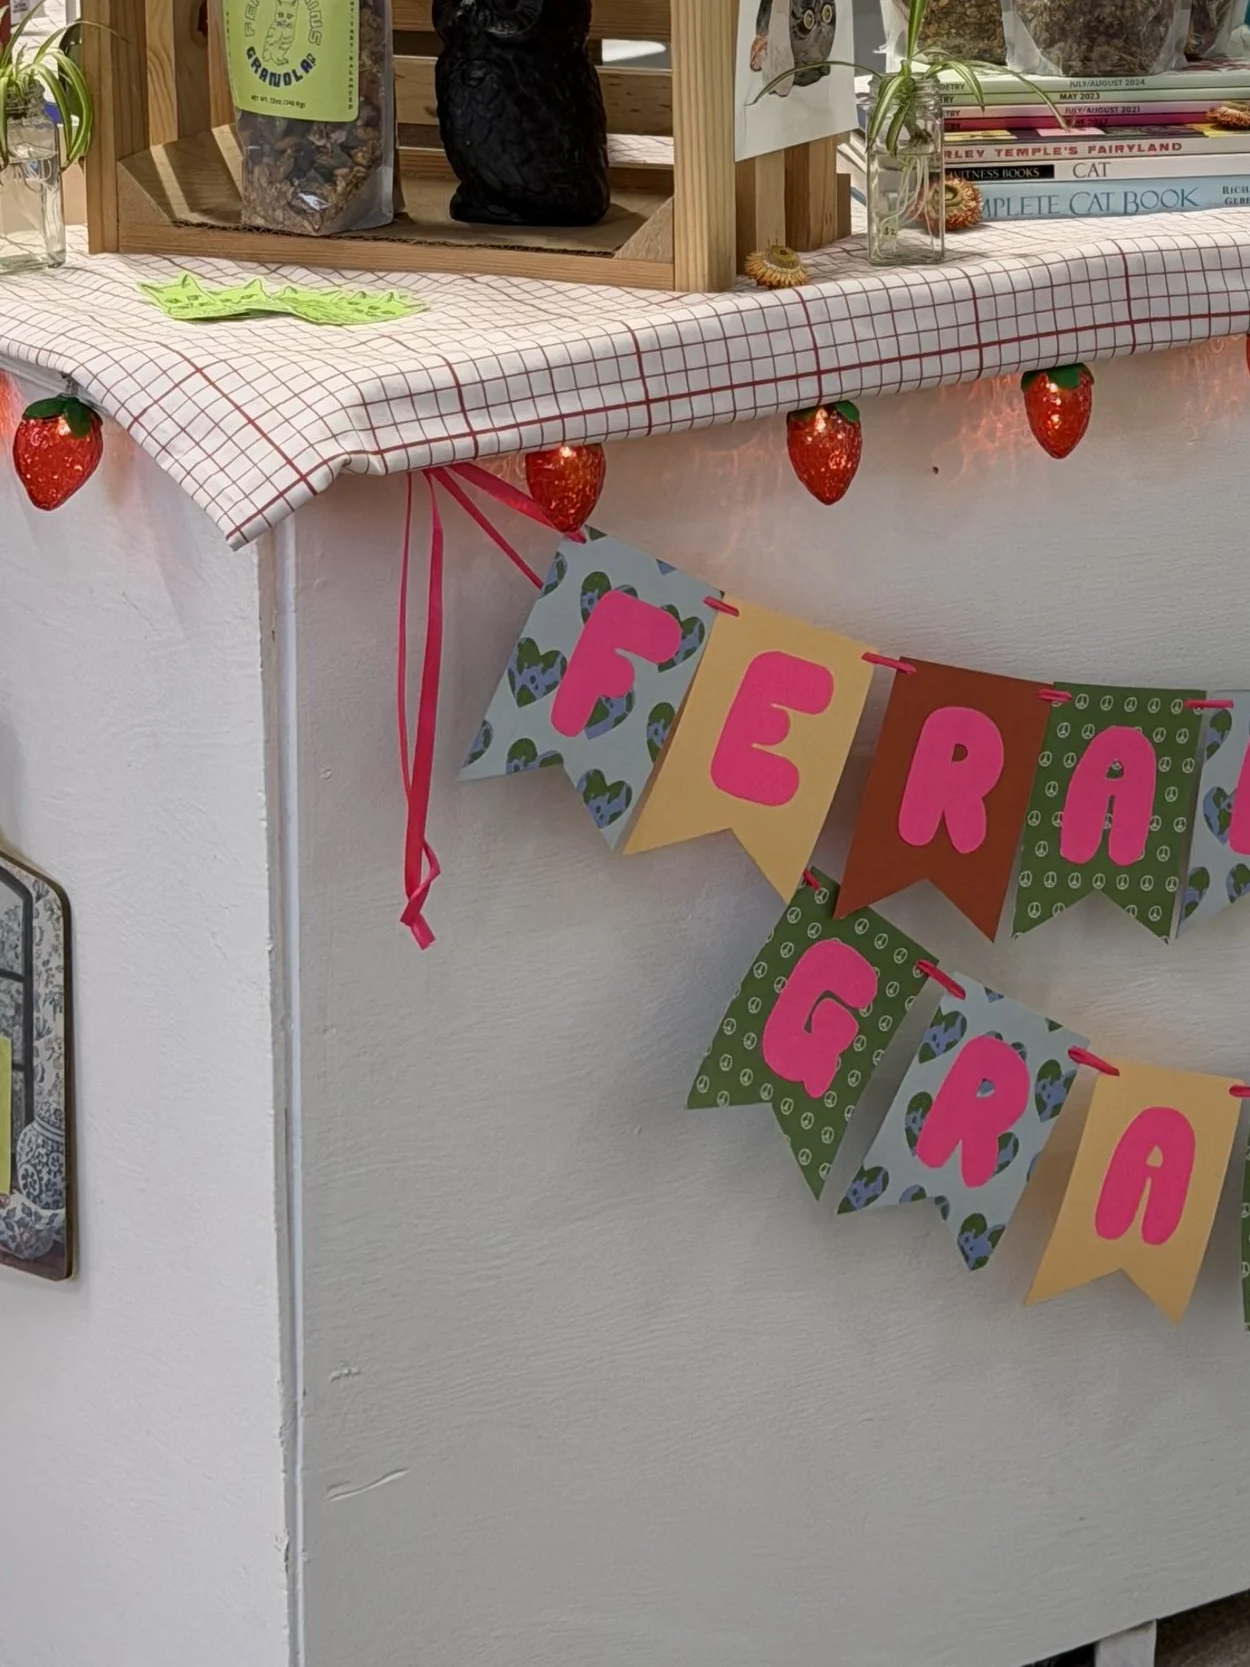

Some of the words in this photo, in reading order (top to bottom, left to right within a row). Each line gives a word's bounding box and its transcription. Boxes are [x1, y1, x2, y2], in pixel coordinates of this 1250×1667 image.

[246, 46, 315, 88] GRANOLA
[1125, 77, 1146, 86] 2024
[1059, 93, 1078, 101] MAY
[1080, 92, 1100, 100] 2023
[1120, 105, 1141, 113] 2021
[944, 148, 985, 159] RLEY
[995, 145, 1078, 158] TEMPLE'S
[1088, 141, 1182, 154] FAIRYLAND
[1002, 166, 1040, 179] BOOKS
[1073, 161, 1111, 178] CAT
[982, 194, 1060, 218] MPLETE
[1068, 191, 1121, 216] CAT
[1123, 186, 1201, 215] BOOK
